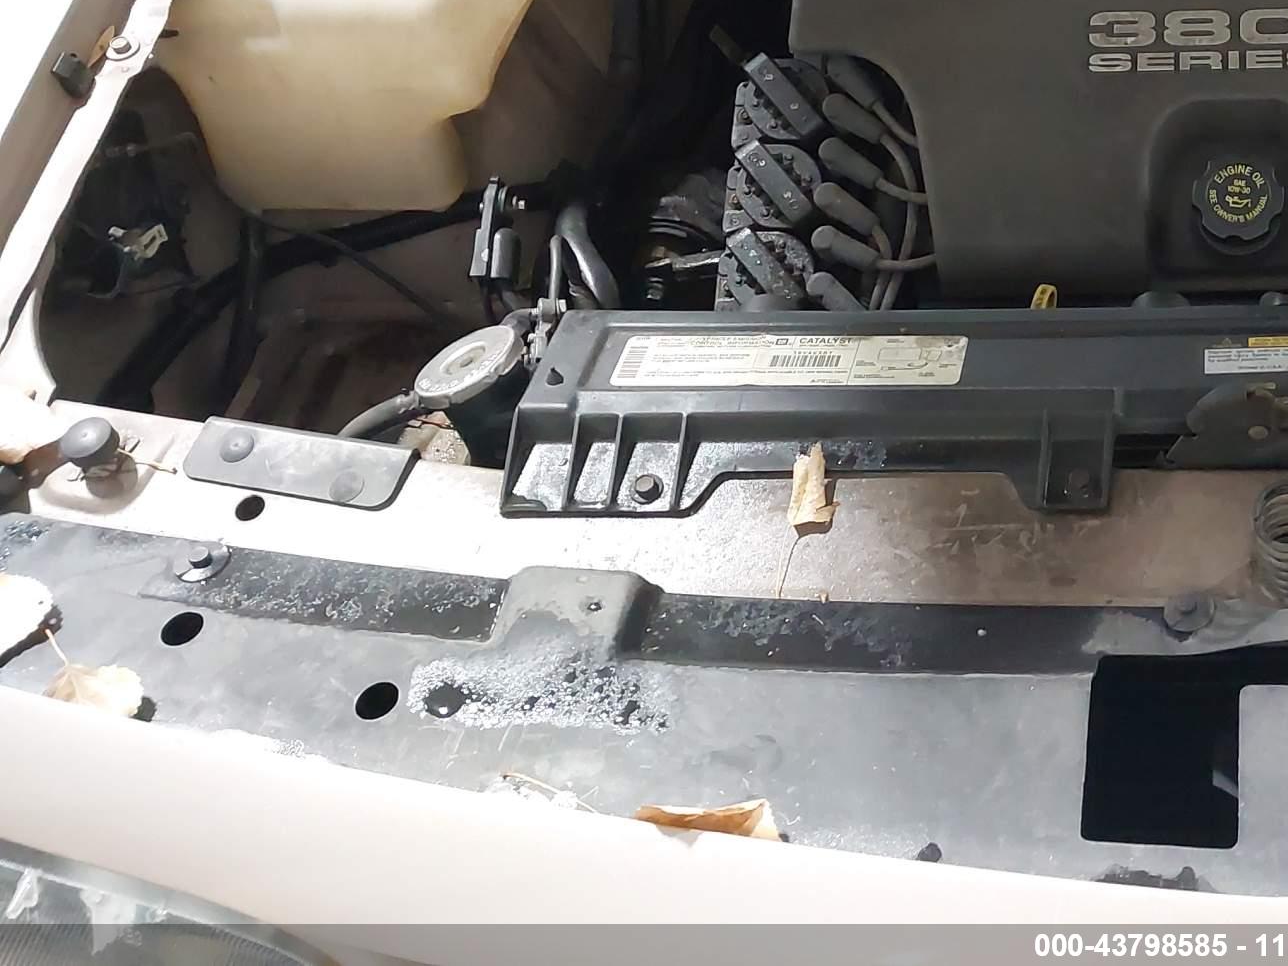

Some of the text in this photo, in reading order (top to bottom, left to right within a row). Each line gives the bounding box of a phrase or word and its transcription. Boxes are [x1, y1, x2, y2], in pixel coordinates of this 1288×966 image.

[1214, 164, 1265, 189] ENGINE OIL
[1209, 189, 1218, 204] SEE
[1245, 194, 1268, 220] MANUAL
